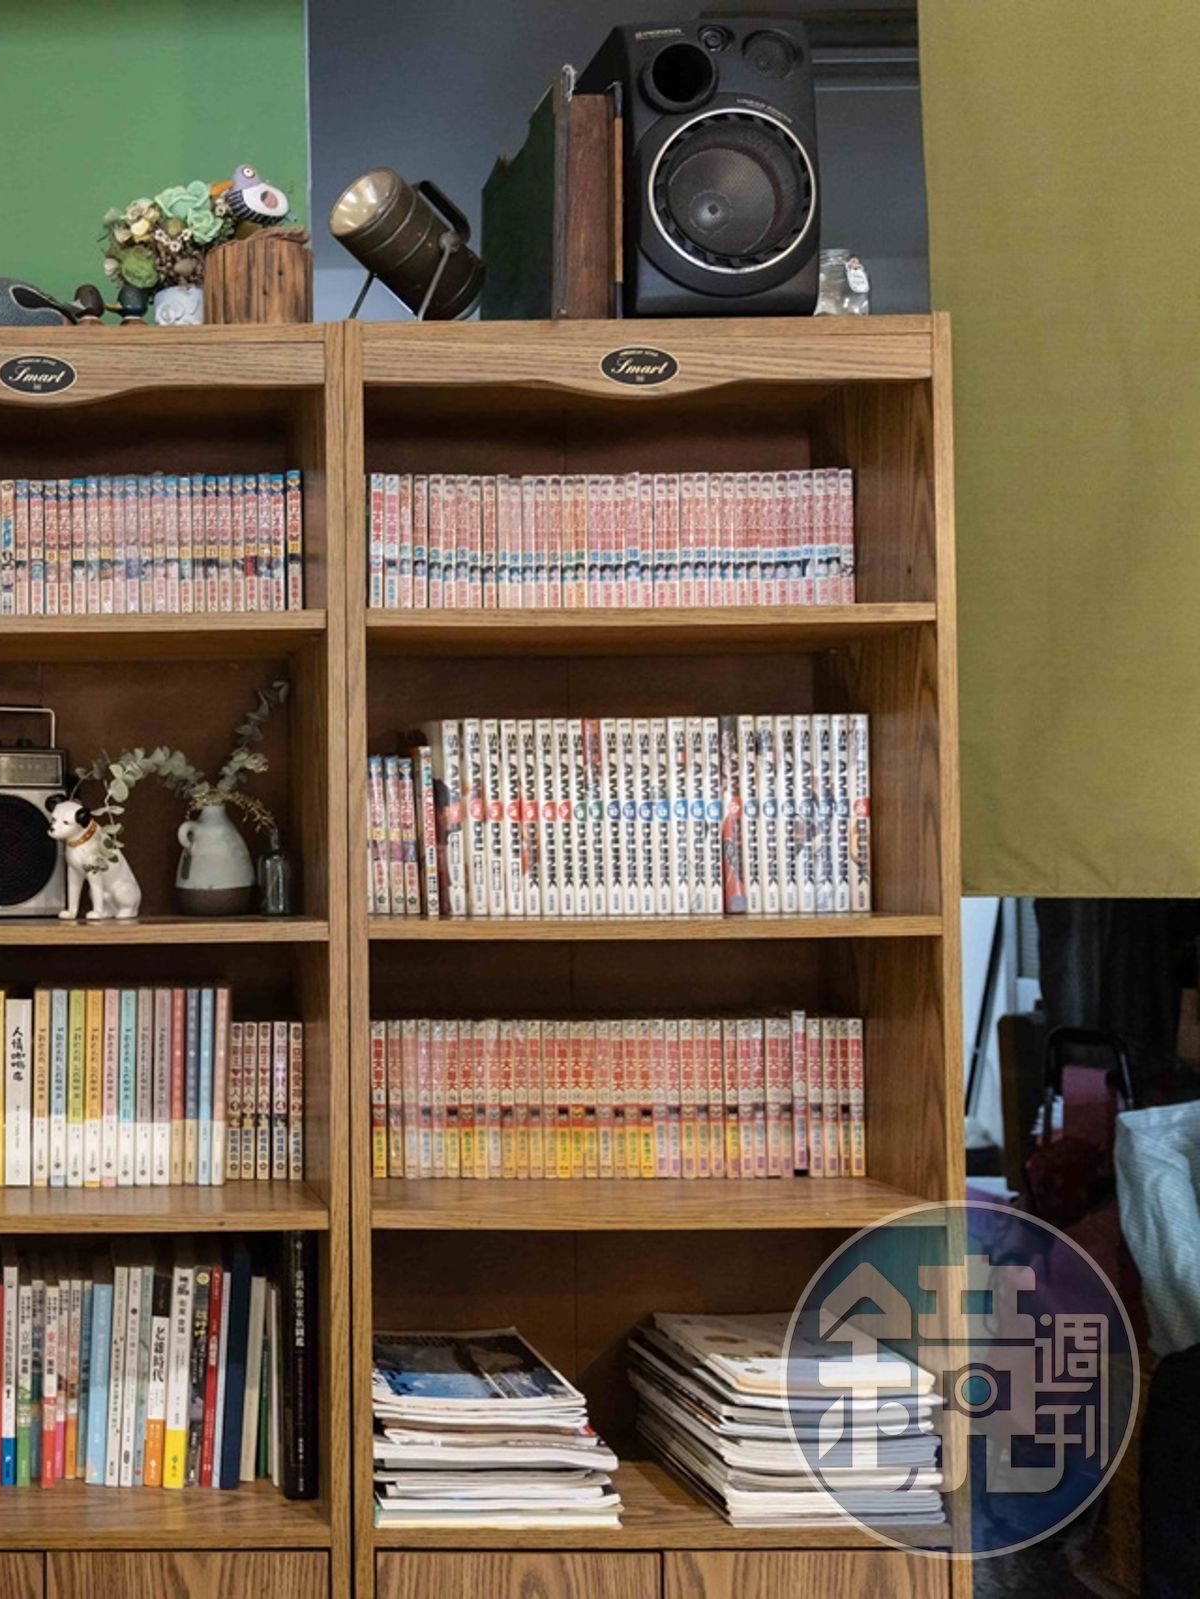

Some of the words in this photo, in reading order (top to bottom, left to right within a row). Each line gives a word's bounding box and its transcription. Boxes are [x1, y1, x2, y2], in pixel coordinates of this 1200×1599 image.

[8, 365, 66, 383] Smart
[611, 357, 669, 374] Smart
[469, 732, 481, 799] SLAM
[488, 733, 500, 800] SLAM
[506, 733, 519, 800] SLAM
[523, 733, 536, 800] SLAM
[541, 733, 553, 800] SLAM
[558, 733, 571, 800] SLAM
[573, 734, 585, 800] SLAM
[606, 732, 618, 799] SLAM
[622, 733, 634, 799] SLAM
[638, 733, 650, 799] SLAM
[655, 733, 668, 799] SLAM
[674, 731, 686, 798] SLAM
[691, 732, 703, 798] SLAM
[708, 733, 719, 799] SLAM
[744, 730, 756, 797] SLAM
[782, 730, 794, 797] SLAM
[838, 730, 848, 797] SLAM
[545, 823, 557, 888] DUNK
[562, 823, 574, 887] DUNK
[577, 823, 589, 888] DUNK
[593, 822, 604, 887] DUNK
[610, 822, 622, 887] DUNK
[626, 822, 638, 887] DUNK
[642, 822, 653, 887] DUNK
[659, 822, 670, 887] DUNK
[677, 821, 688, 887] DUNK
[694, 822, 706, 887] DUNK
[710, 822, 722, 887] DUNK
[748, 820, 759, 884] DUNK
[767, 820, 778, 884] DUNK
[785, 820, 796, 885] DUNK
[838, 819, 849, 885] DUNK
